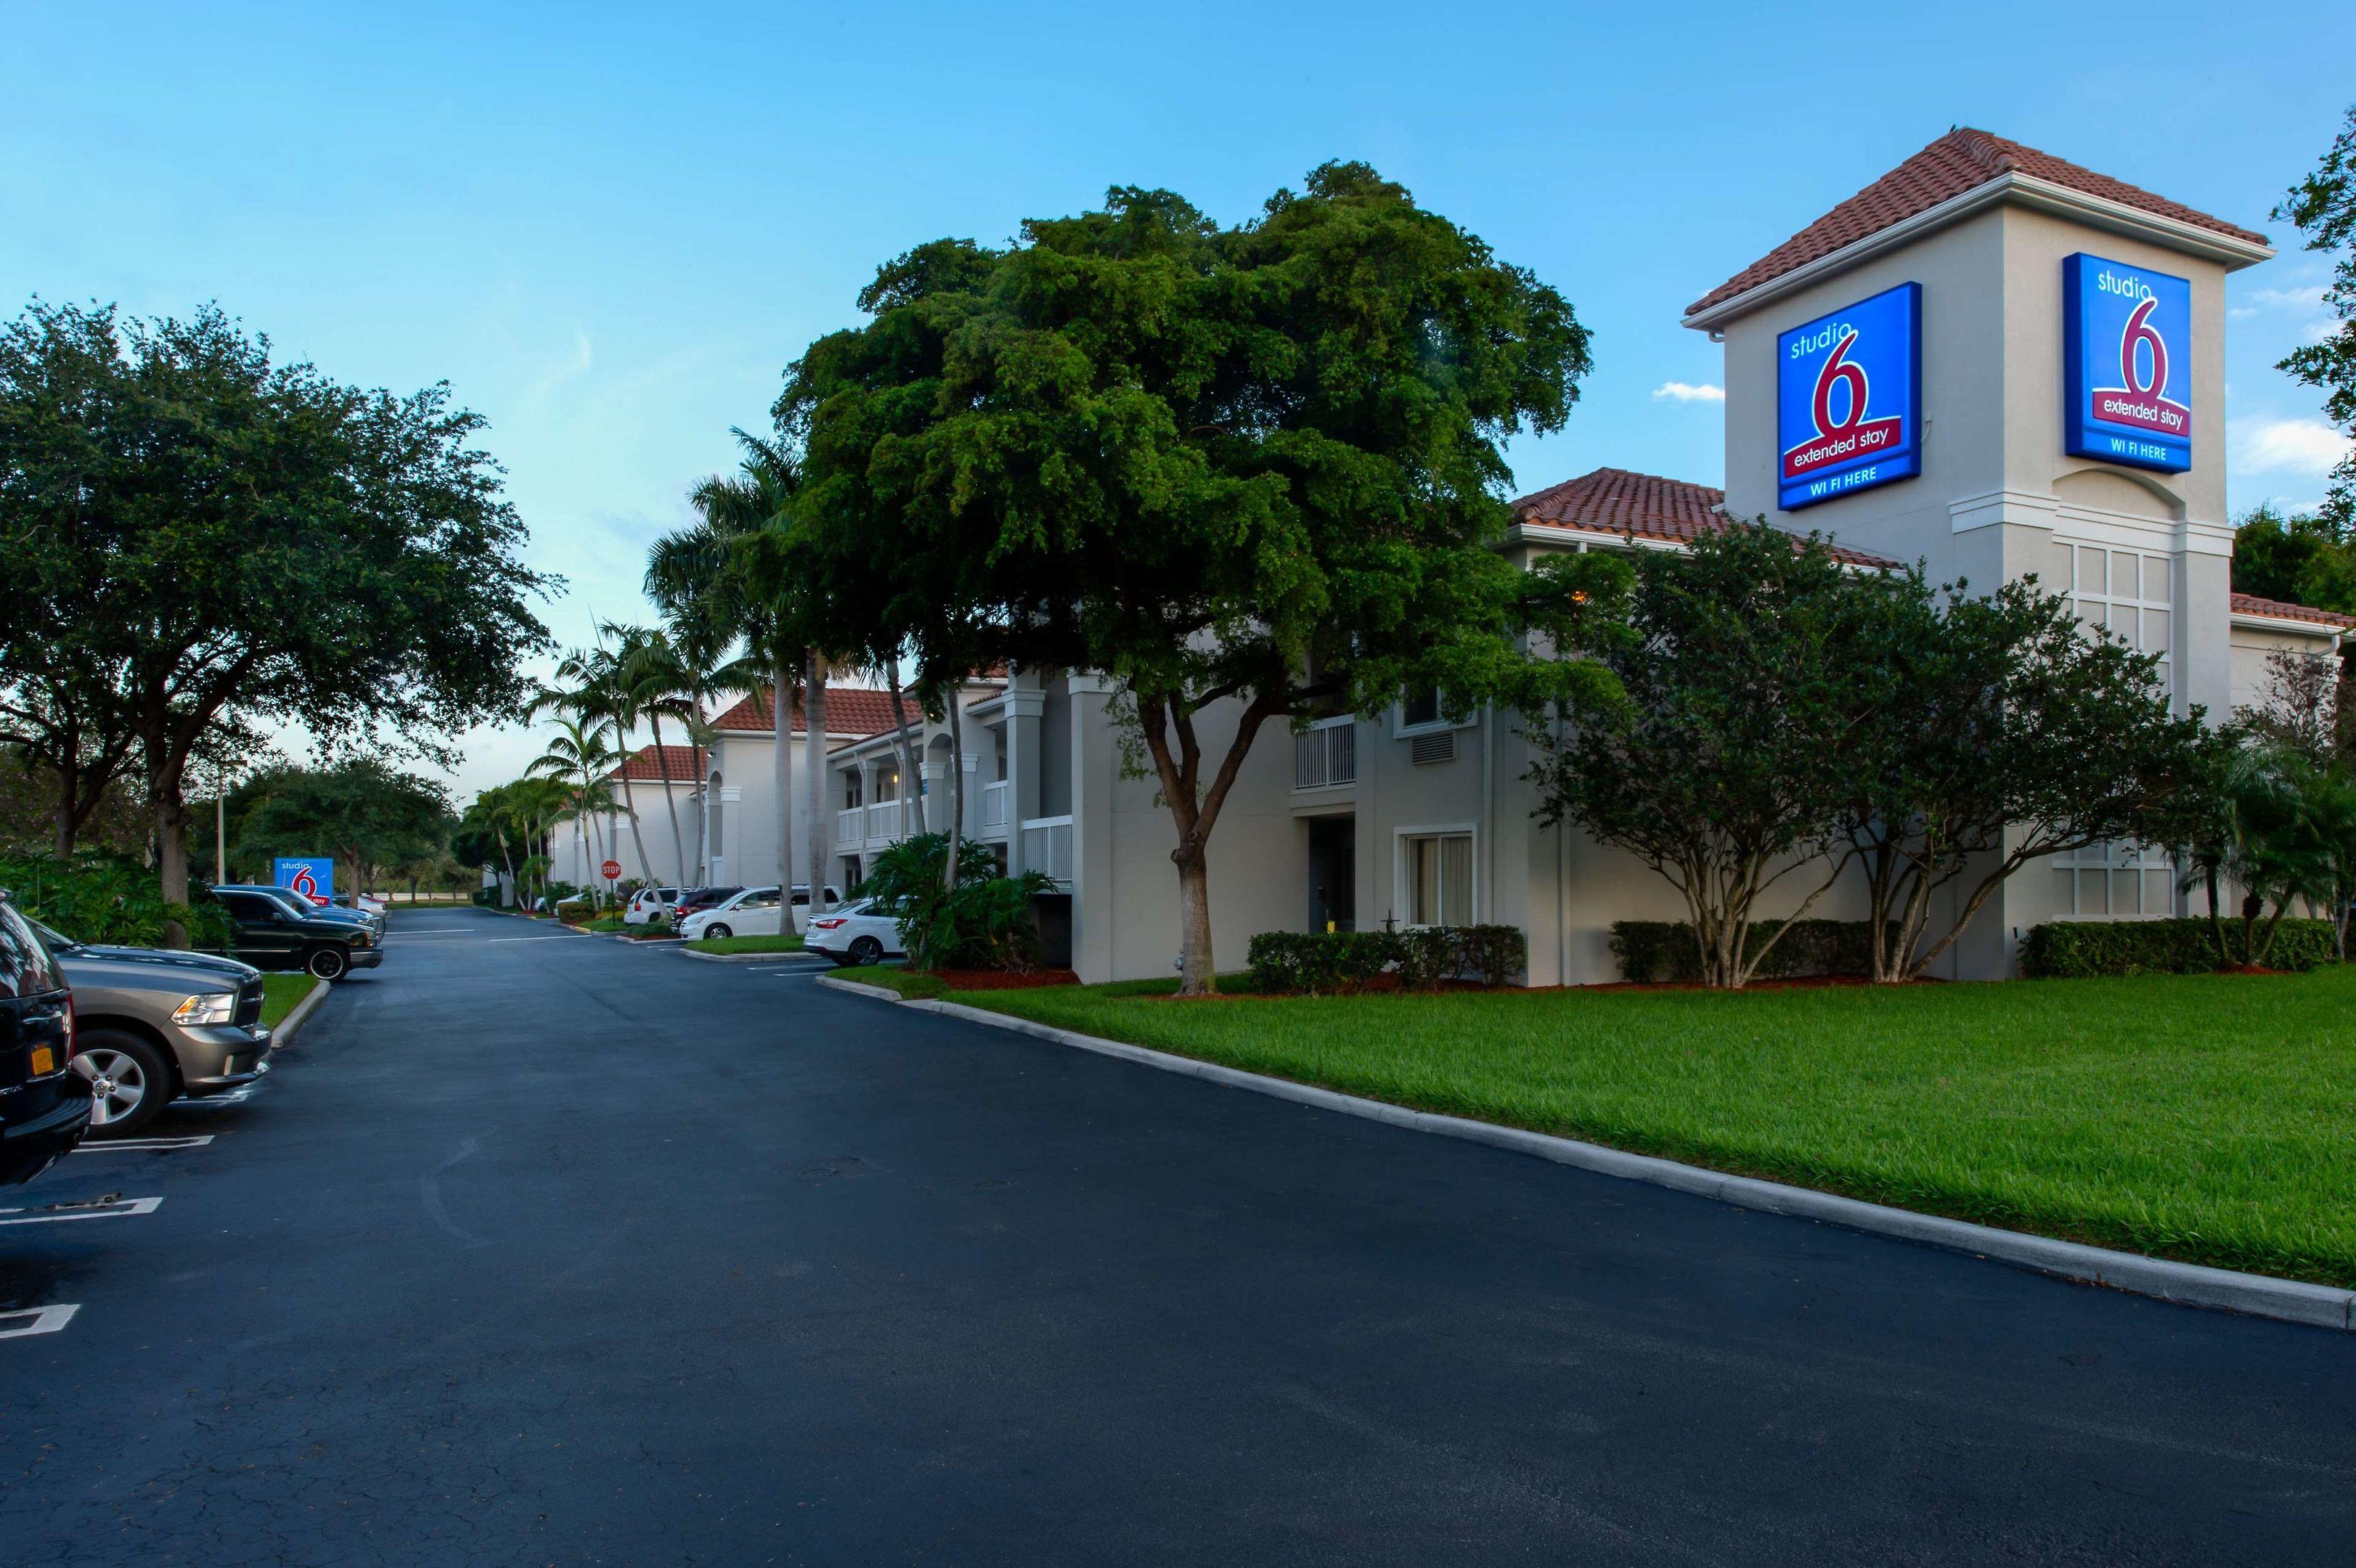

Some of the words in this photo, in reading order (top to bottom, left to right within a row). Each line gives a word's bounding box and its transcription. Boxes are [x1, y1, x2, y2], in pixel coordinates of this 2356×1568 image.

[2098, 270, 2151, 300] studio
[1790, 323, 1851, 359] studio
[2120, 296, 2168, 397] 6
[1811, 329, 1869, 436] 6
[2104, 399, 2157, 422] extended
[2161, 409, 2182, 430] stay
[1794, 435, 1855, 467] extended
[1860, 428, 1888, 447] stay
[2111, 438, 2125, 453] WI
[2129, 441, 2137, 455] FI
[2141, 444, 2166, 460] HERE
[1811, 482, 1827, 497] WI
[1831, 477, 1841, 490] FI
[1845, 467, 1877, 486] HERE
[292, 867, 317, 897] 6
